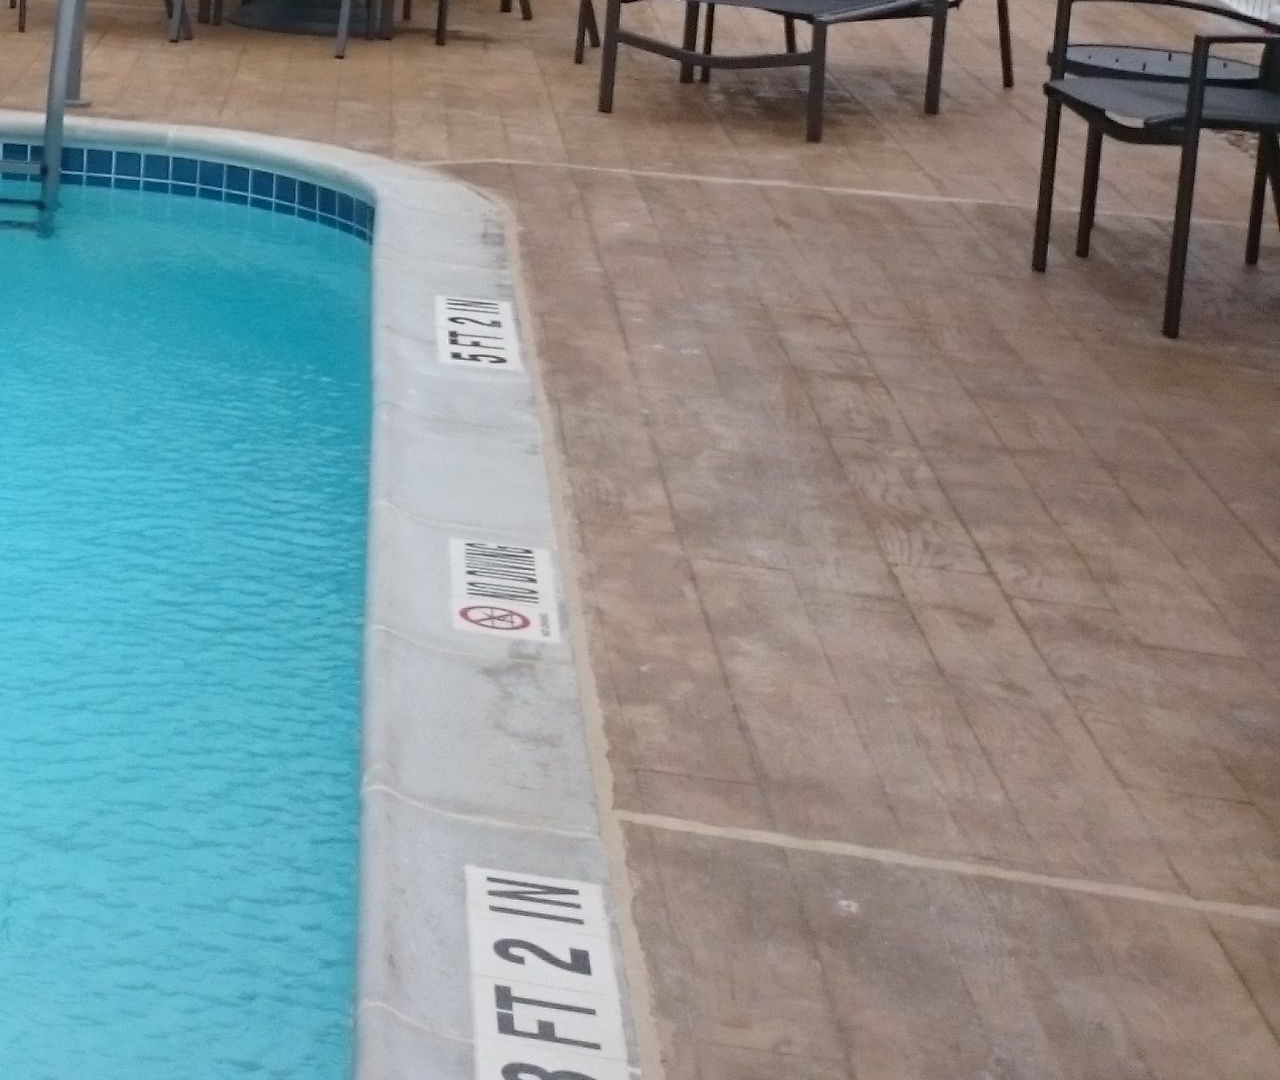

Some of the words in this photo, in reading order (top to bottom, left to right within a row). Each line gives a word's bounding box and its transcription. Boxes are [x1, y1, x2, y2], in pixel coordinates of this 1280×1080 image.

[446, 298, 500, 314] IN
[448, 316, 503, 328] 2
[448, 330, 505, 350] FT
[450, 352, 507, 364] 5
[464, 542, 538, 584] DIVING
[466, 582, 539, 604] NO
[487, 877, 585, 925] IN
[493, 938, 592, 976] 2
[494, 984, 602, 1050] FT
